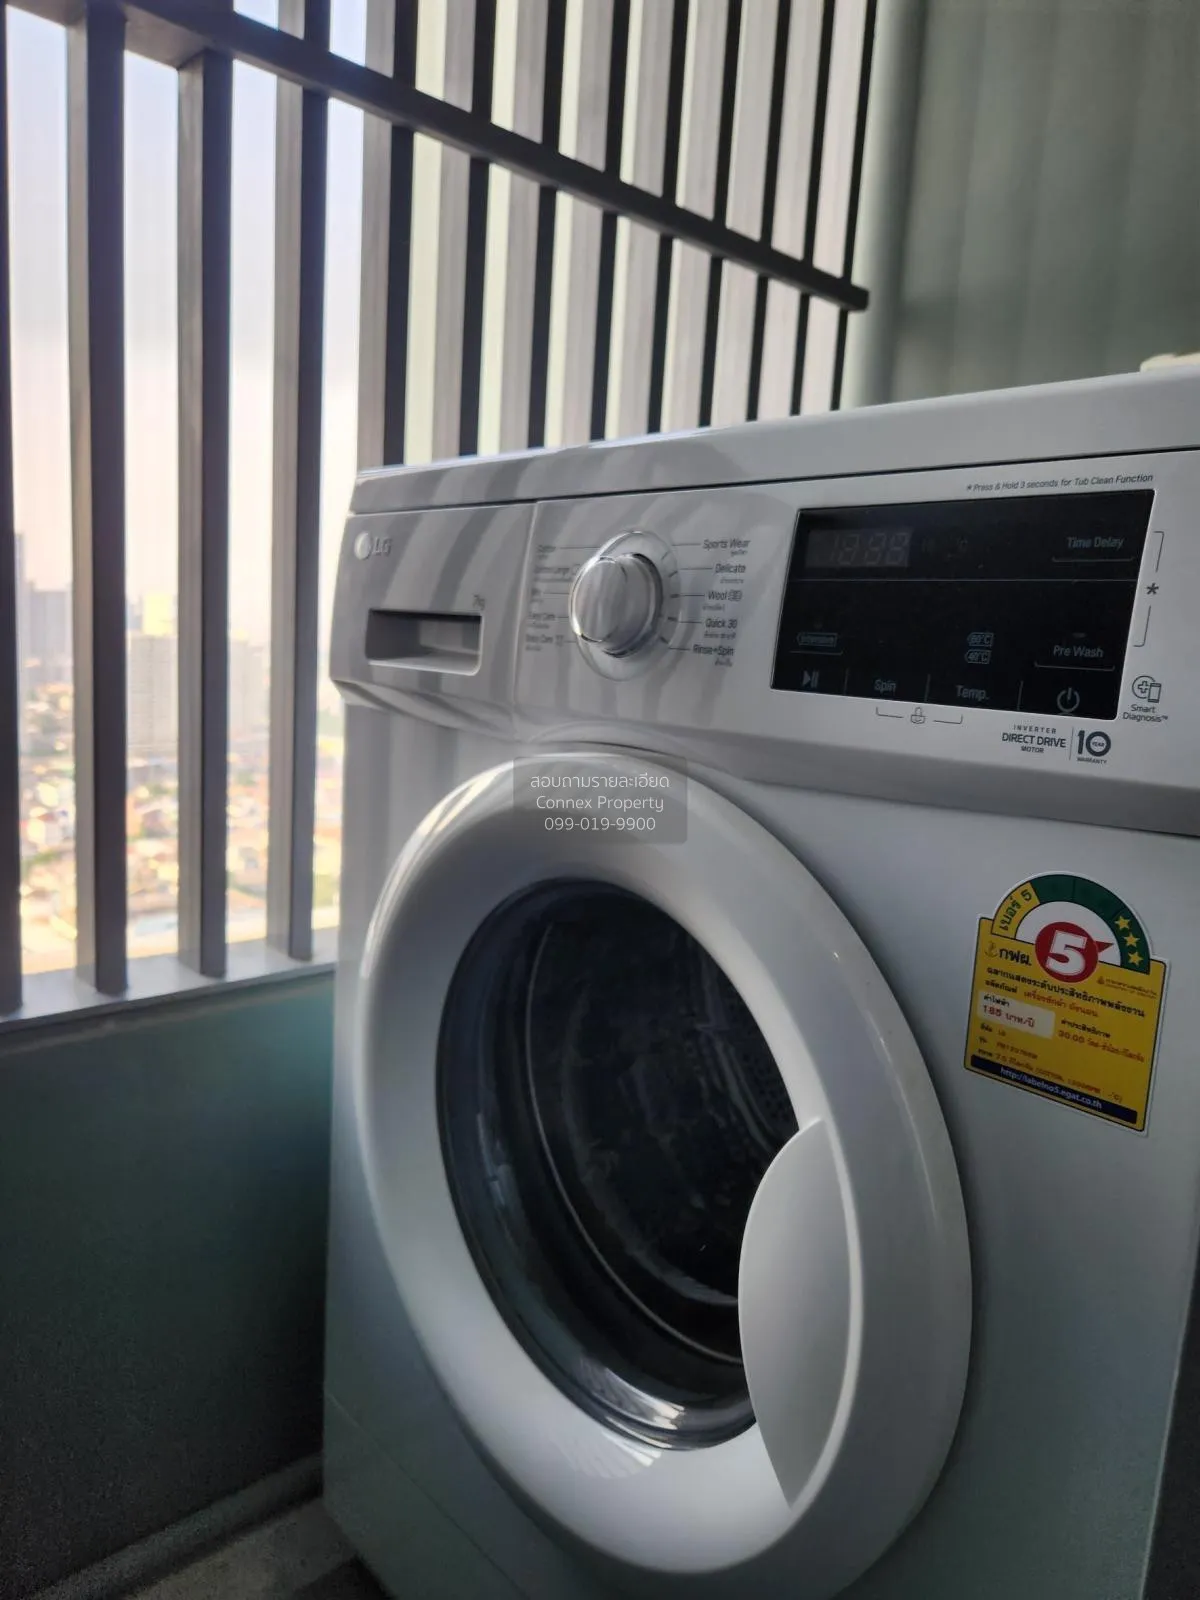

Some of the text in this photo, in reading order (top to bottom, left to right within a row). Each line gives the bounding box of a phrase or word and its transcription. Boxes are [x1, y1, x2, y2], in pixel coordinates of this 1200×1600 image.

[972, 484, 993, 492] Press
[1002, 482, 1019, 490] Hold
[1026, 480, 1059, 489] seconds
[1060, 479, 1072, 487] for
[1074, 478, 1088, 486] Tub
[1091, 476, 1114, 485] Clean
[1115, 474, 1153, 485] Function
[373, 537, 393, 557] LG
[702, 538, 751, 551] Sports Wear
[1067, 536, 1124, 550] Time Delay
[715, 563, 746, 574] Delicate
[708, 590, 728, 601] Wool
[705, 618, 726, 628] Quick
[1053, 645, 1104, 658] Pre Wash
[874, 679, 897, 693] Spin
[956, 685, 989, 701] Temp.
[1130, 704, 1156, 714] Smart
[1013, 724, 1057, 735] INVERTER
[1002, 732, 1067, 748] DIRECT DRIVE
[1077, 729, 1112, 757] 10
[1020, 746, 1044, 754] MOTOR
[1077, 757, 1108, 765] WARRANTY
[999, 889, 1032, 931] เบอร์ 5
[999, 948, 1032, 966] กฟผ.
[1046, 930, 1087, 976] 5
